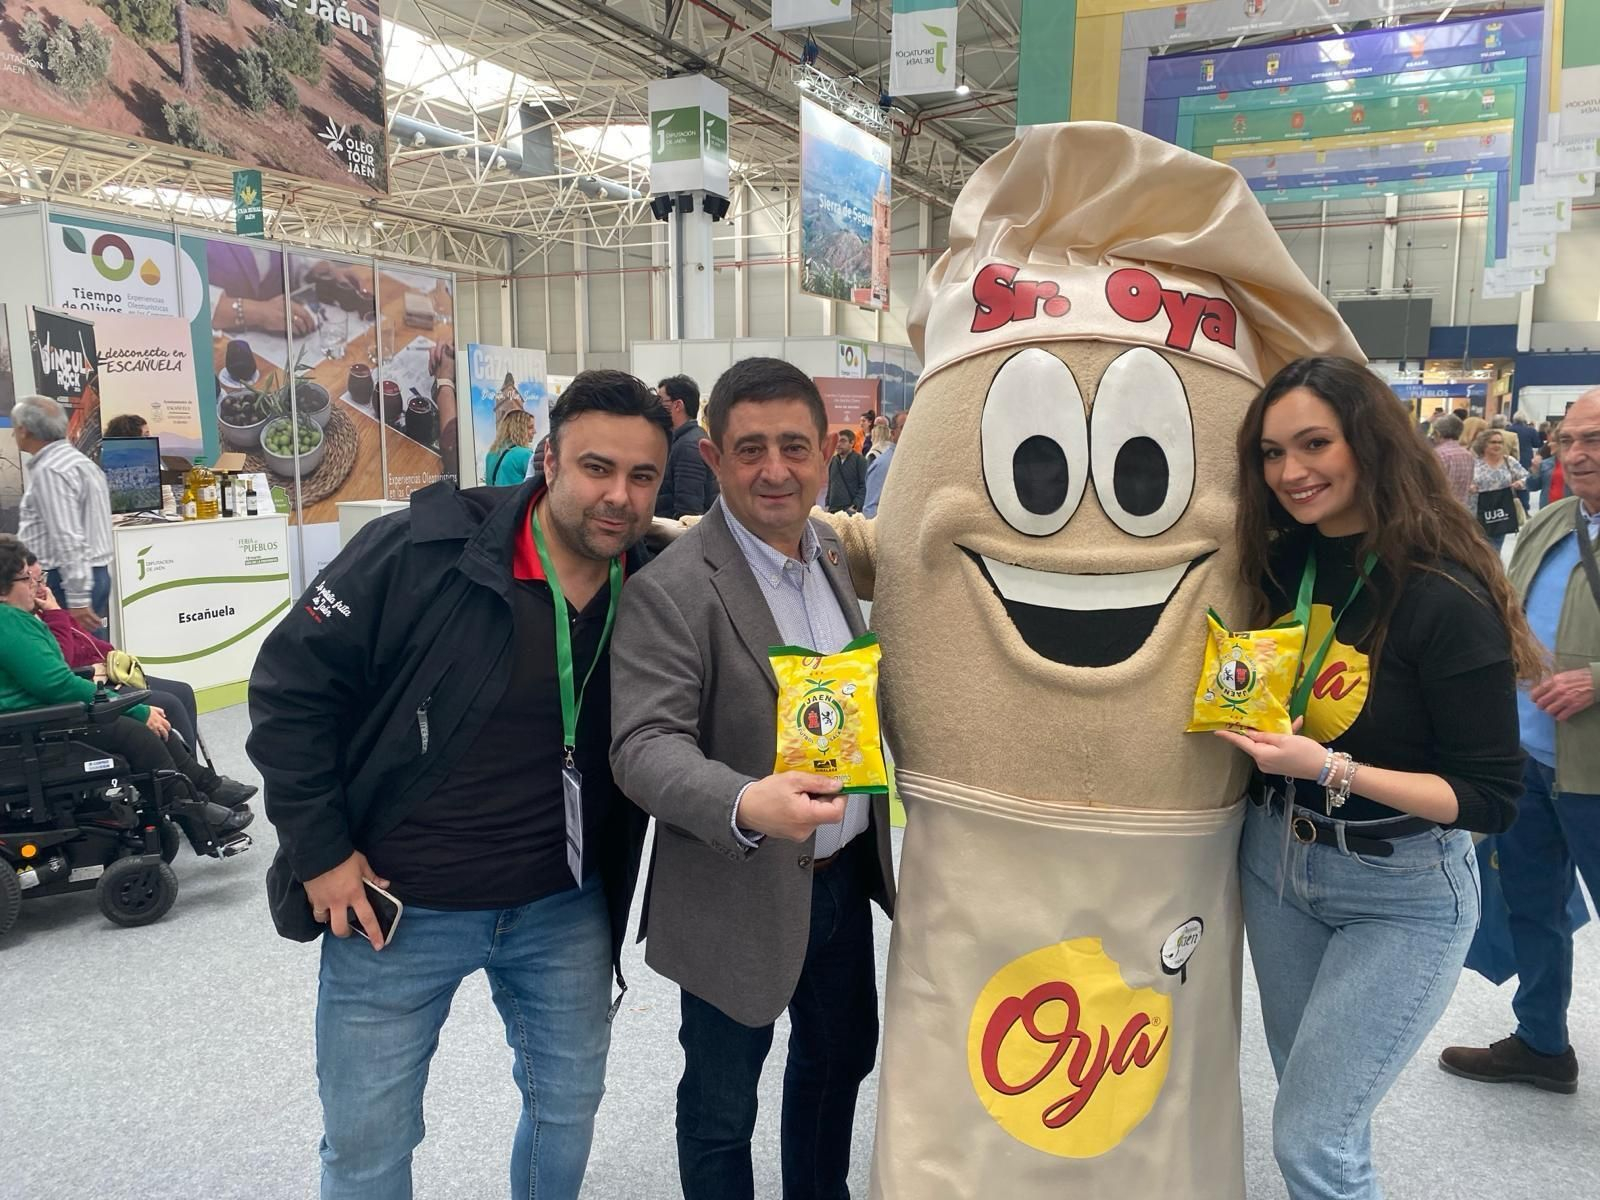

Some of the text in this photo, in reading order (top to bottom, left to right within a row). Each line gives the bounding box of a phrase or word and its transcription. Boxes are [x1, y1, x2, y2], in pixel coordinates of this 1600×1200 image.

[345, 138, 374, 155] OLEO
[346, 149, 375, 167] TOUR
[819, 193, 841, 214] Sierra
[842, 201, 852, 218] de
[72, 287, 122, 305] Tiempo
[970, 263, 1237, 352] Sr. Oya
[106, 347, 170, 359] desconecta
[172, 349, 187, 358] en
[107, 358, 182, 373] ESCAÑUELA
[388, 473, 421, 487] Experiencias
[243, 541, 278, 553] PUEBLOS
[178, 605, 235, 624] Escañuela
[980, 981, 1169, 1129] Oya
